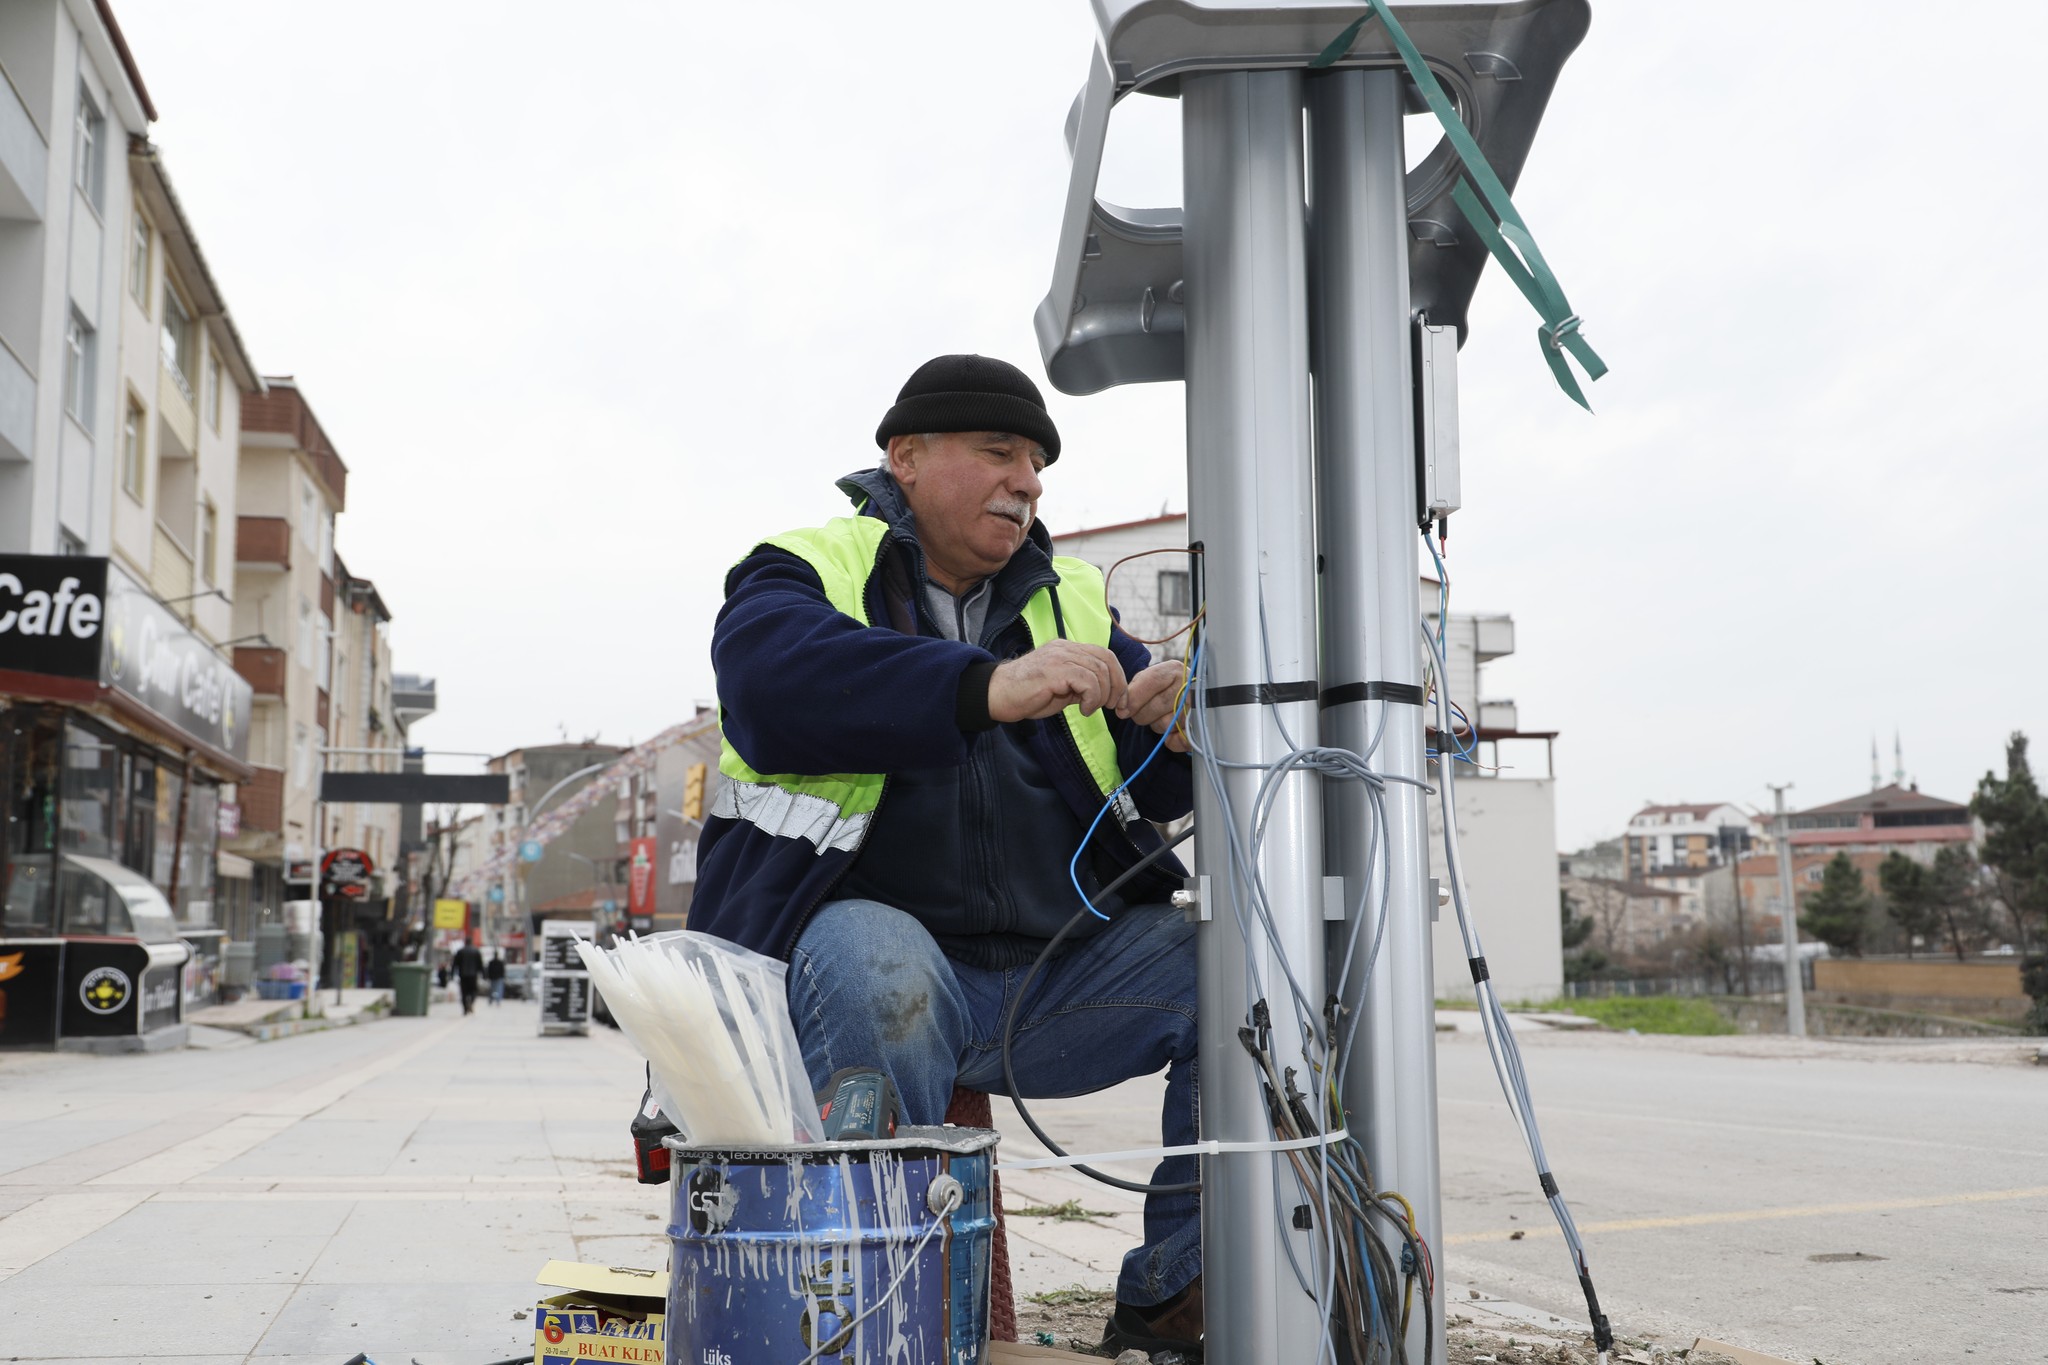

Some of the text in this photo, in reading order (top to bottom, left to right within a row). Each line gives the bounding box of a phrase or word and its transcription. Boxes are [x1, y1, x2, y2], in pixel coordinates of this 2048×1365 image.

[0, 572, 102, 639] Cafe
[181, 650, 221, 725] Cafe
[543, 1315, 565, 1345] 6
[578, 1342, 618, 1359] BUAT
[702, 1347, 732, 1365] Lüks
